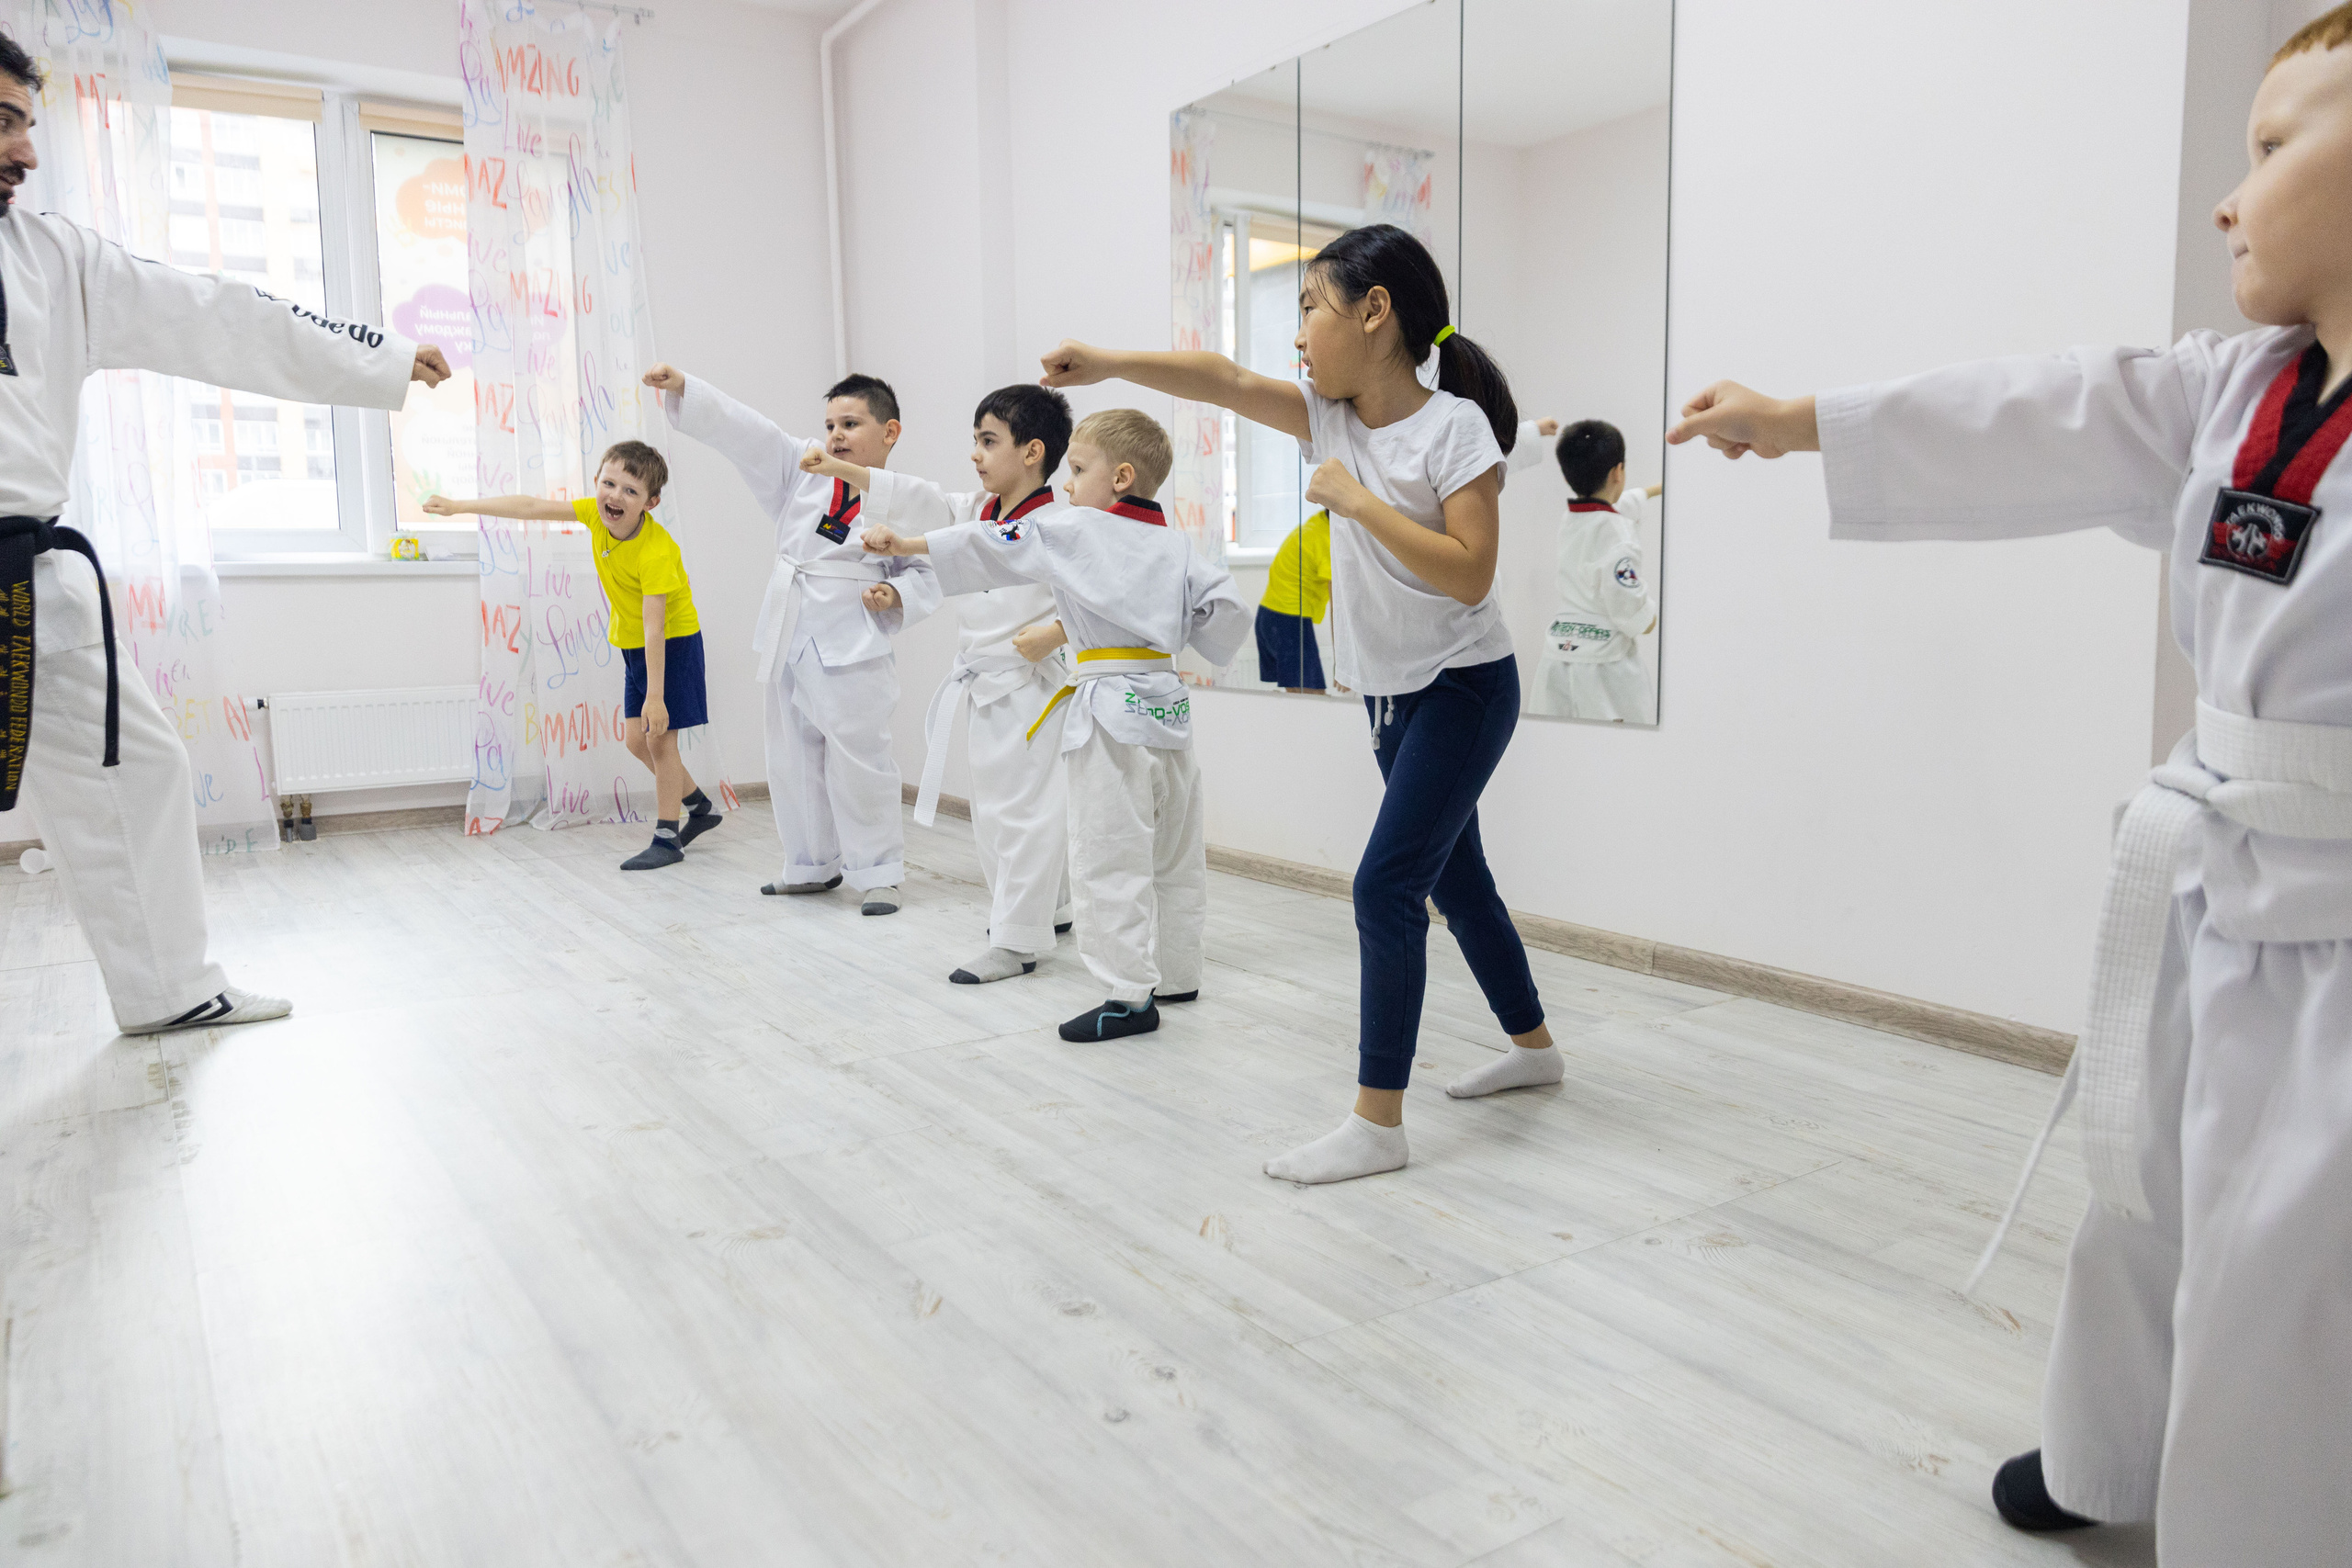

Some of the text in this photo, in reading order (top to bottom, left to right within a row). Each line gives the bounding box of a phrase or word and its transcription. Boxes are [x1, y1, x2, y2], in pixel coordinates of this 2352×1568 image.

[526, 546, 572, 599] Live
[6, 581, 31, 791] WORLD TAEKWONDO FEDERATION
[547, 764, 590, 815] Live
